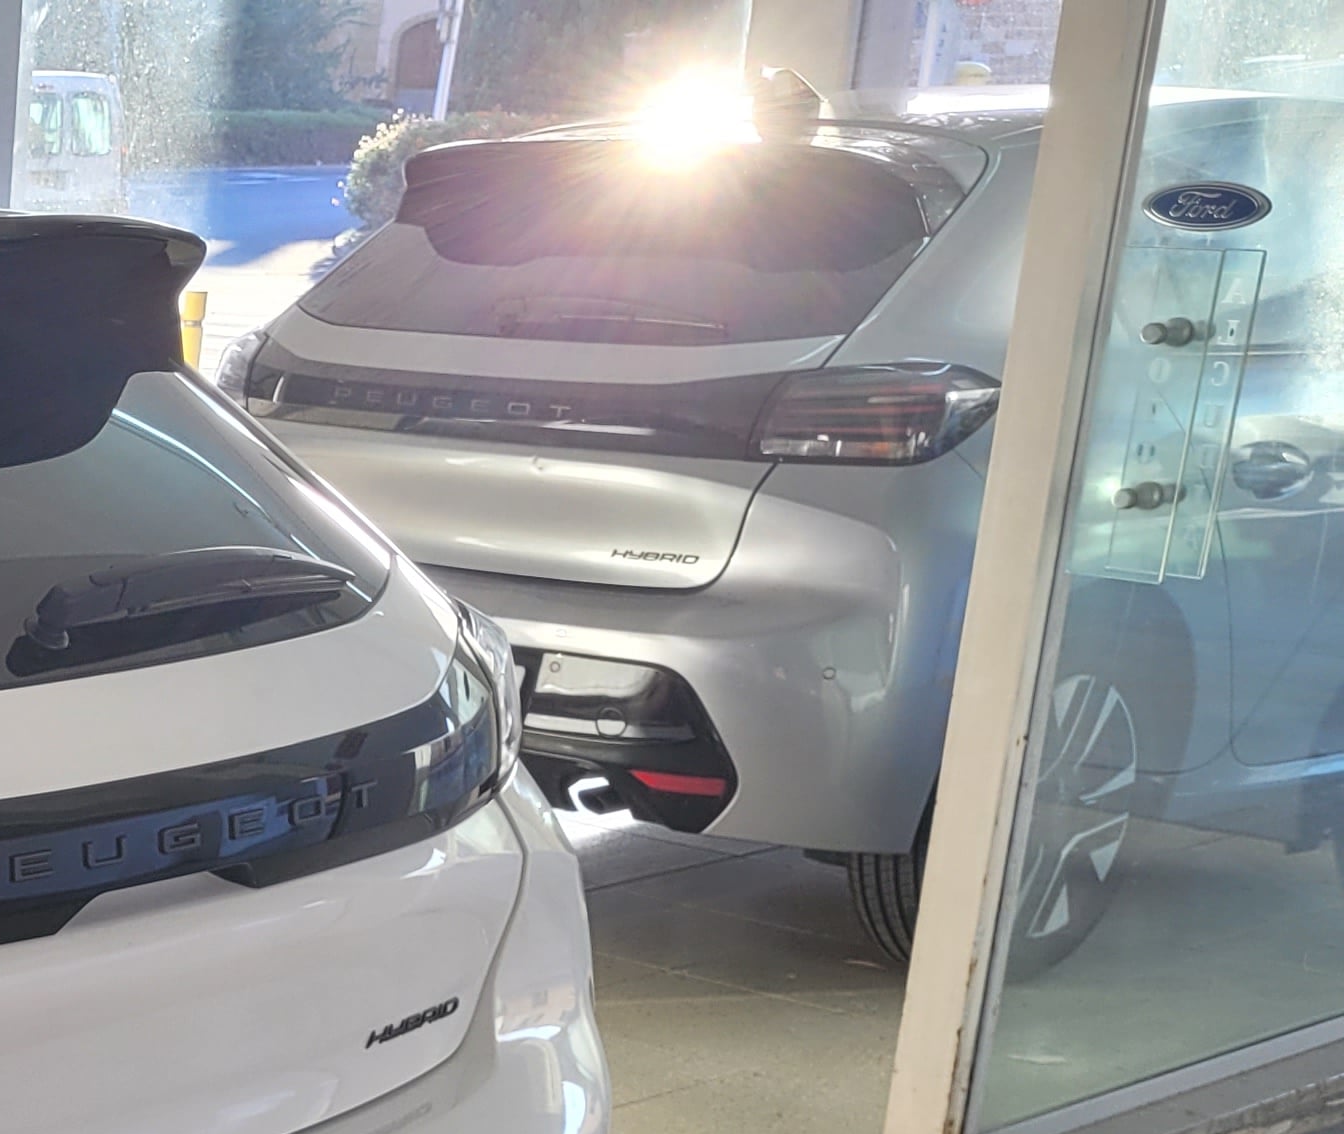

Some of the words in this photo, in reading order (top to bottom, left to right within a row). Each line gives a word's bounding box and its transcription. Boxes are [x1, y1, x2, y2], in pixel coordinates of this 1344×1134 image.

[1168, 191, 1237, 219] Ford
[334, 386, 572, 418] PEUGEOT
[610, 548, 700, 565] HYBRID
[364, 996, 460, 1050] HYBRID
